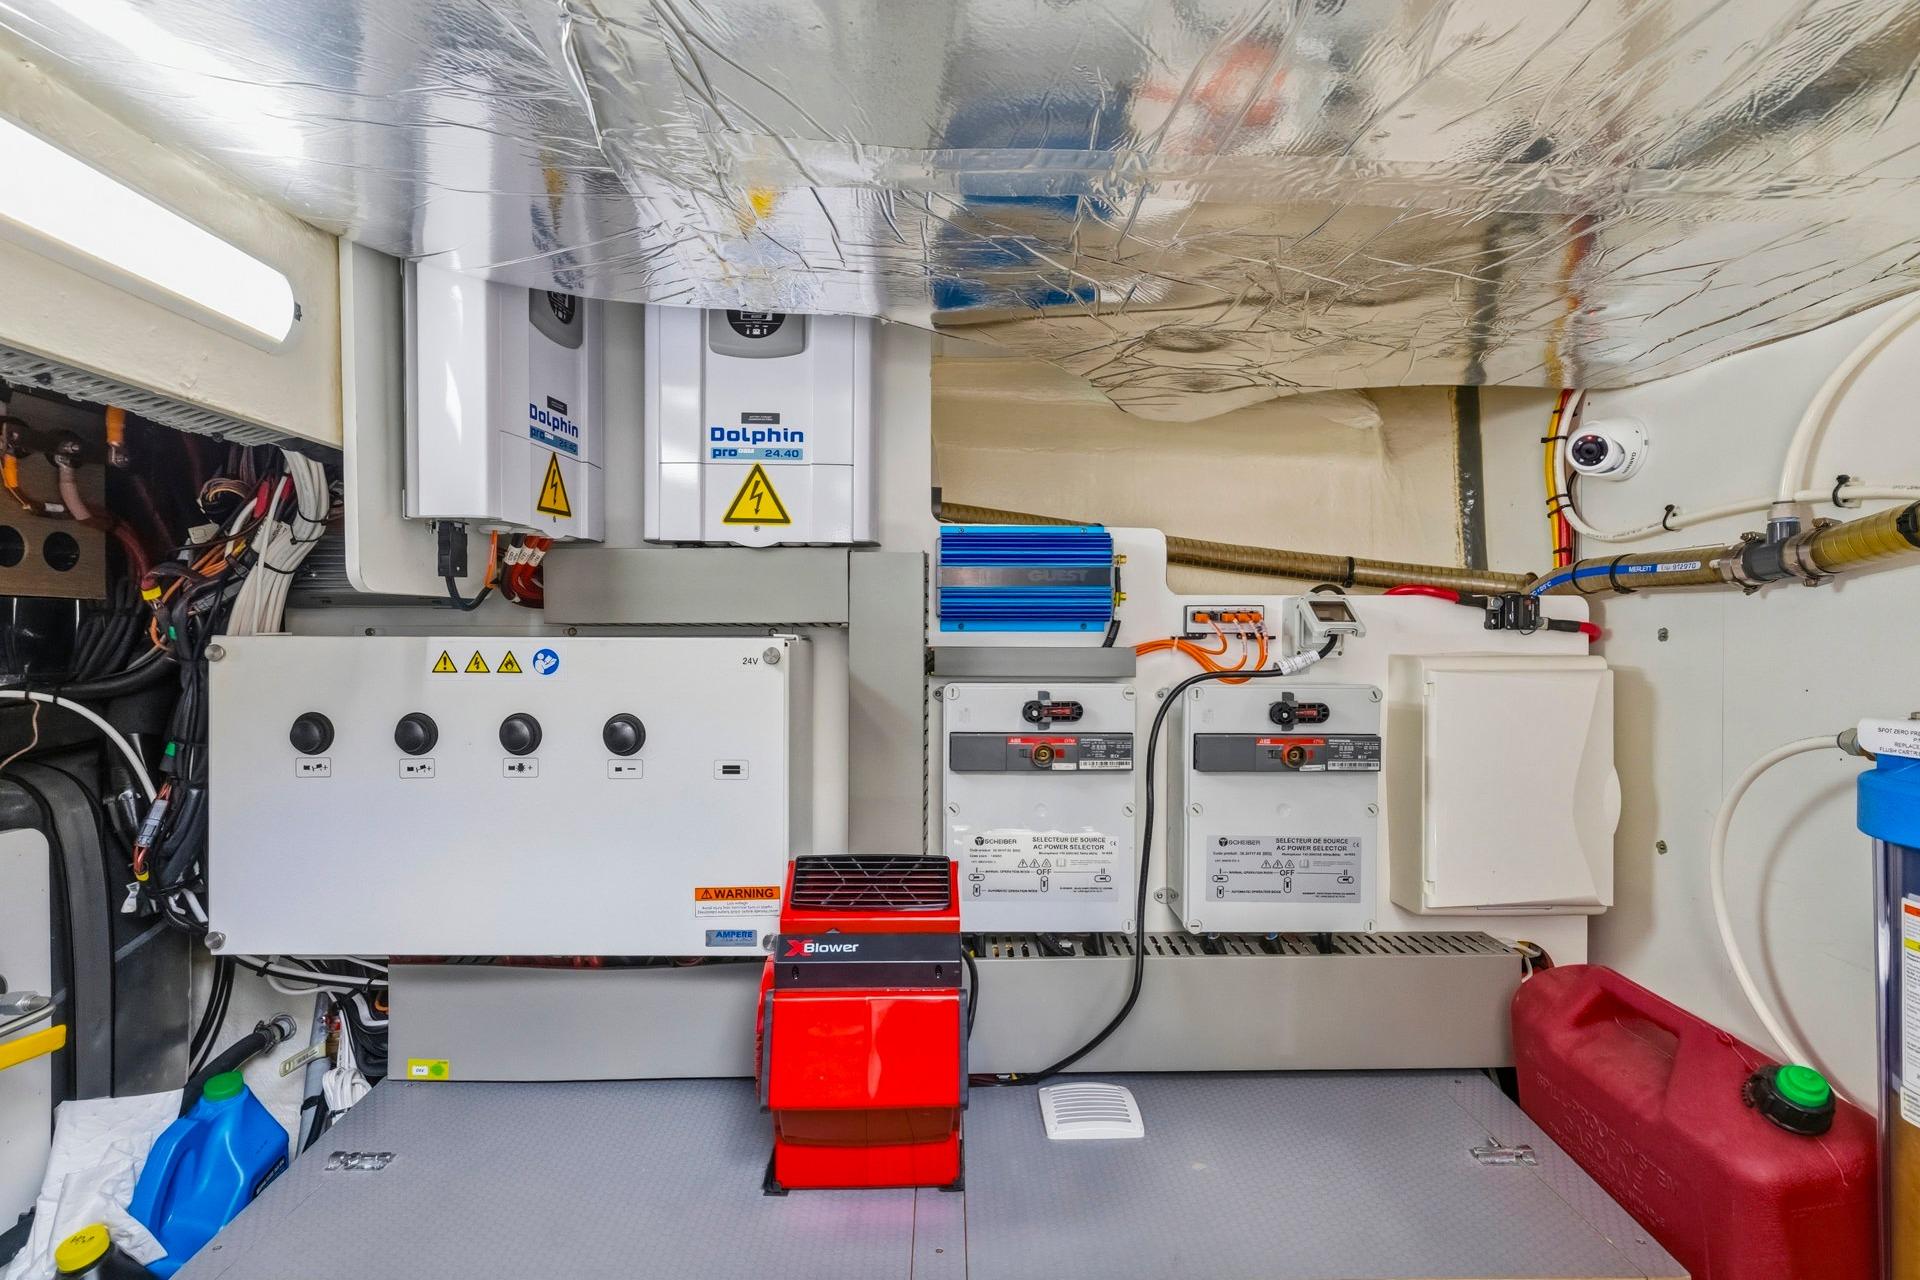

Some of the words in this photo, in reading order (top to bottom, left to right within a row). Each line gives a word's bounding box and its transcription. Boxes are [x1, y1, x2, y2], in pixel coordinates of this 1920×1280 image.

[529, 403, 578, 438] Dolphin
[711, 427, 804, 445] Dolphin
[712, 448, 738, 459] pro
[765, 449, 799, 458] 24.40
[742, 657, 759, 665] 24V
[1032, 836, 1069, 844] SELECTEUR
[1080, 836, 1106, 844] SOURCE
[714, 888, 774, 899] WARNING
[715, 930, 753, 938] AMPERE
